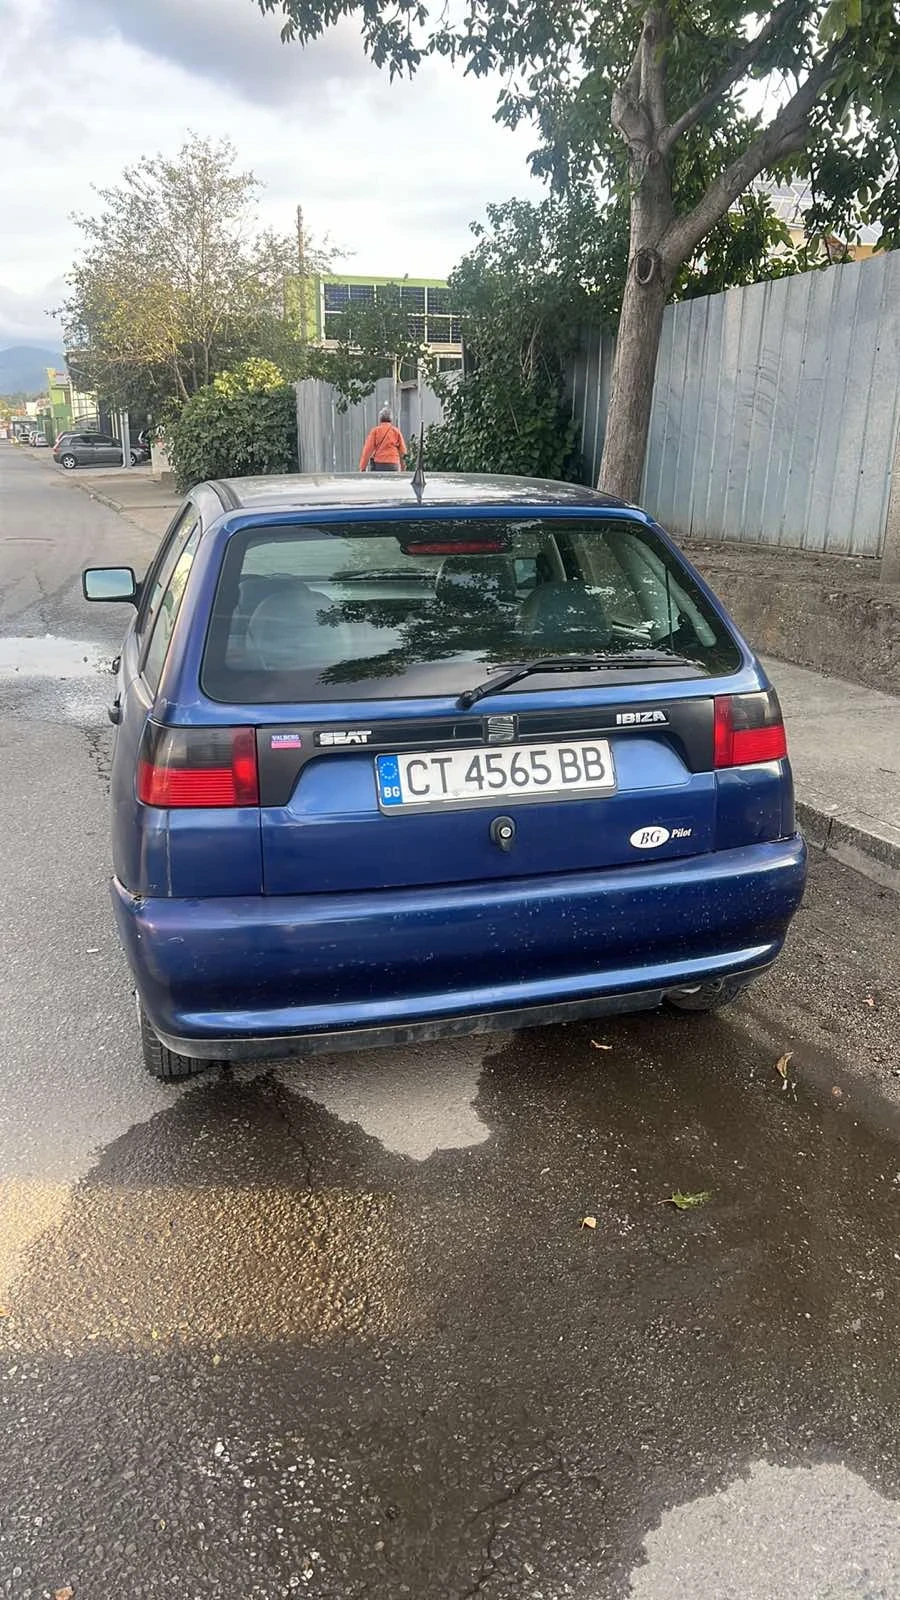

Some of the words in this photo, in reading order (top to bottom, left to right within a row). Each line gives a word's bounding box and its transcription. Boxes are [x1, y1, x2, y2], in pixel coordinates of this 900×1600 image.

[616, 710, 667, 725] IBIZA
[319, 730, 372, 746] SEAT
[405, 757, 453, 796] CT
[465, 749, 552, 790] 4565
[558, 746, 606, 784] BB
[383, 786, 401, 798] BG
[639, 829, 662, 845] BG
[670, 827, 692, 839] Pilot
